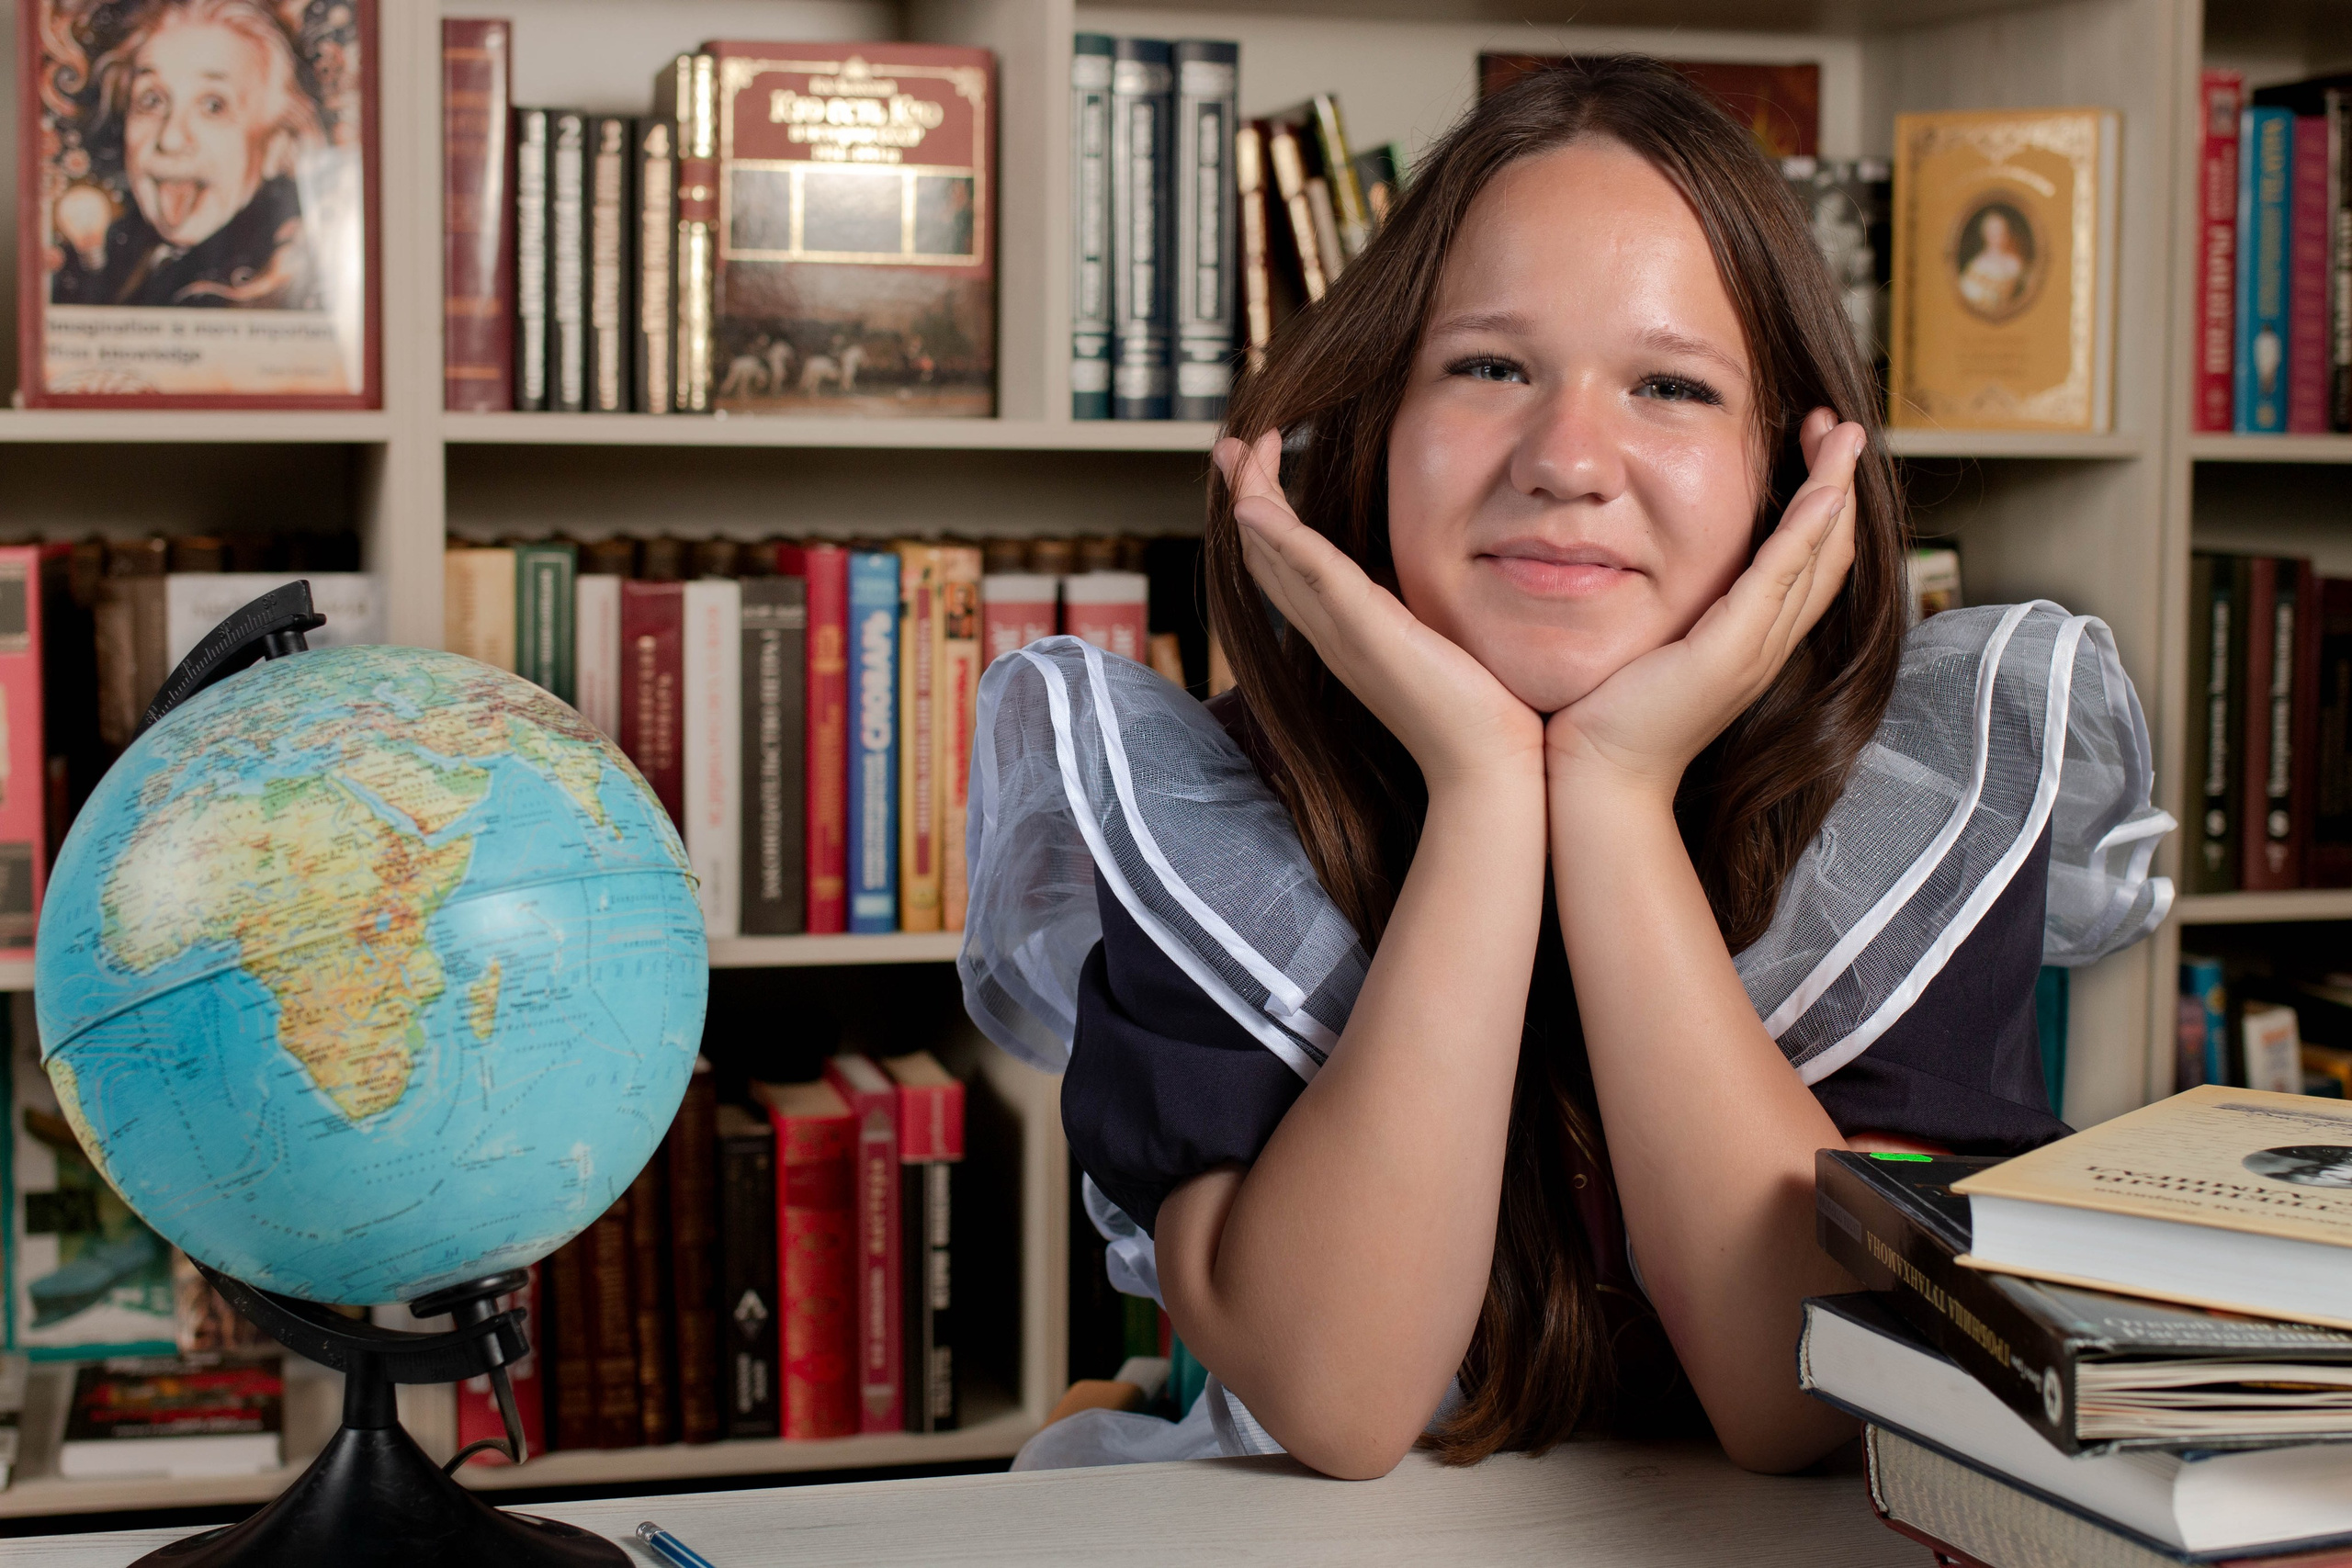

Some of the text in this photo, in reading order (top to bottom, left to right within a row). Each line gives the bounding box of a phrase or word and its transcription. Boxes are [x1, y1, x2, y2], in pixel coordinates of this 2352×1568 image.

[859, 611, 892, 750] СЛОВАРЬ
[1866, 1230, 2010, 1368] ГРОБНИЦА ТУТАНХАМОНА
